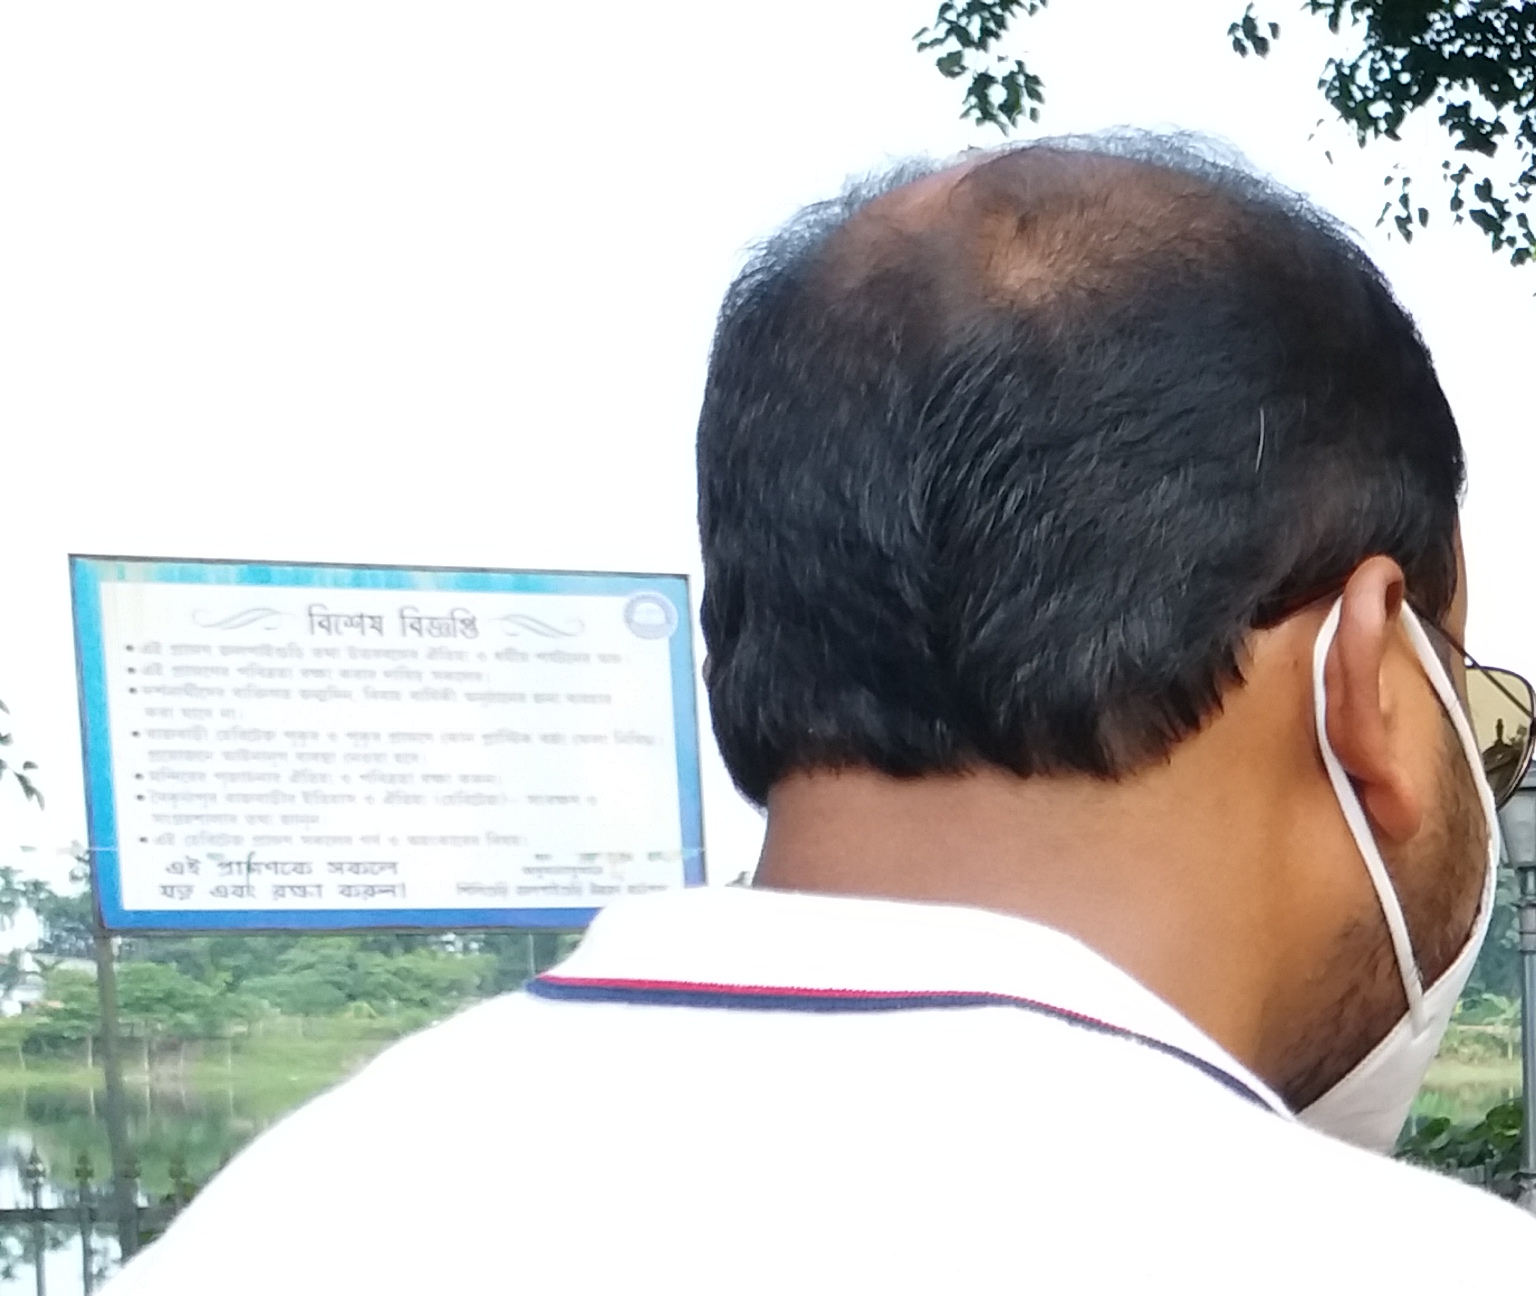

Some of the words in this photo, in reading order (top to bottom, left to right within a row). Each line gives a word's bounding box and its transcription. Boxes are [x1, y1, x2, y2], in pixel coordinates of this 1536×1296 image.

[308, 604, 384, 636] বিশেষ
[399, 606, 480, 640] বিজ্ঞপ্তি
[165, 855, 201, 876] এই
[326, 860, 399, 876] সকলে
